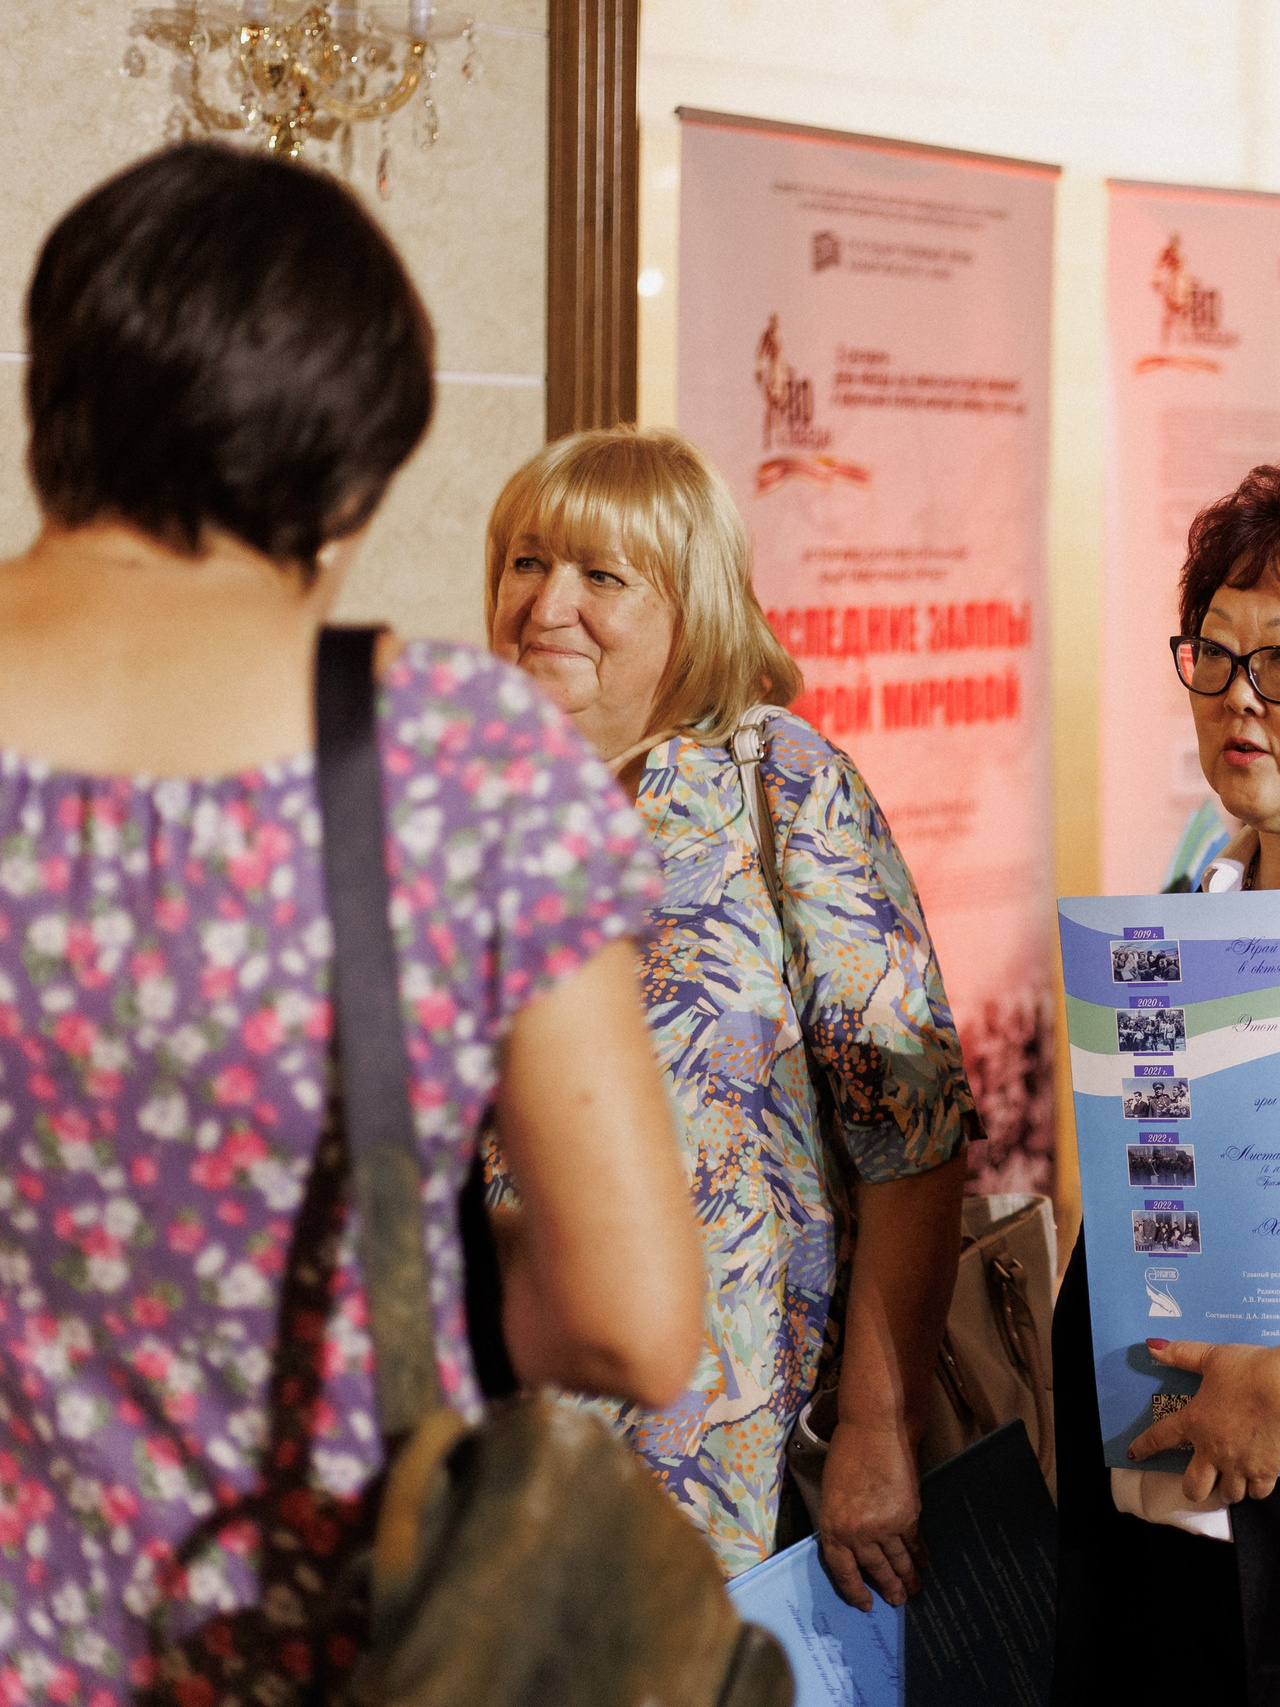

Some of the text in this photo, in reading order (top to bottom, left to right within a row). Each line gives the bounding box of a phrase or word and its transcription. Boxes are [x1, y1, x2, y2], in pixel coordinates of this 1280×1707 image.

[765, 606, 917, 664] ОСЛЕДНИЕ
[1133, 930, 1151, 939] 2019
[1225, 936, 1279, 960] «Край
[1238, 960, 1248, 974] в
[1137, 998, 1158, 1007] 2020
[1232, 1013, 1278, 1032] «Этот
[1143, 1066, 1162, 1076] 2021
[1148, 1134, 1167, 1143] 2022
[1153, 1201, 1172, 1210] 2022
